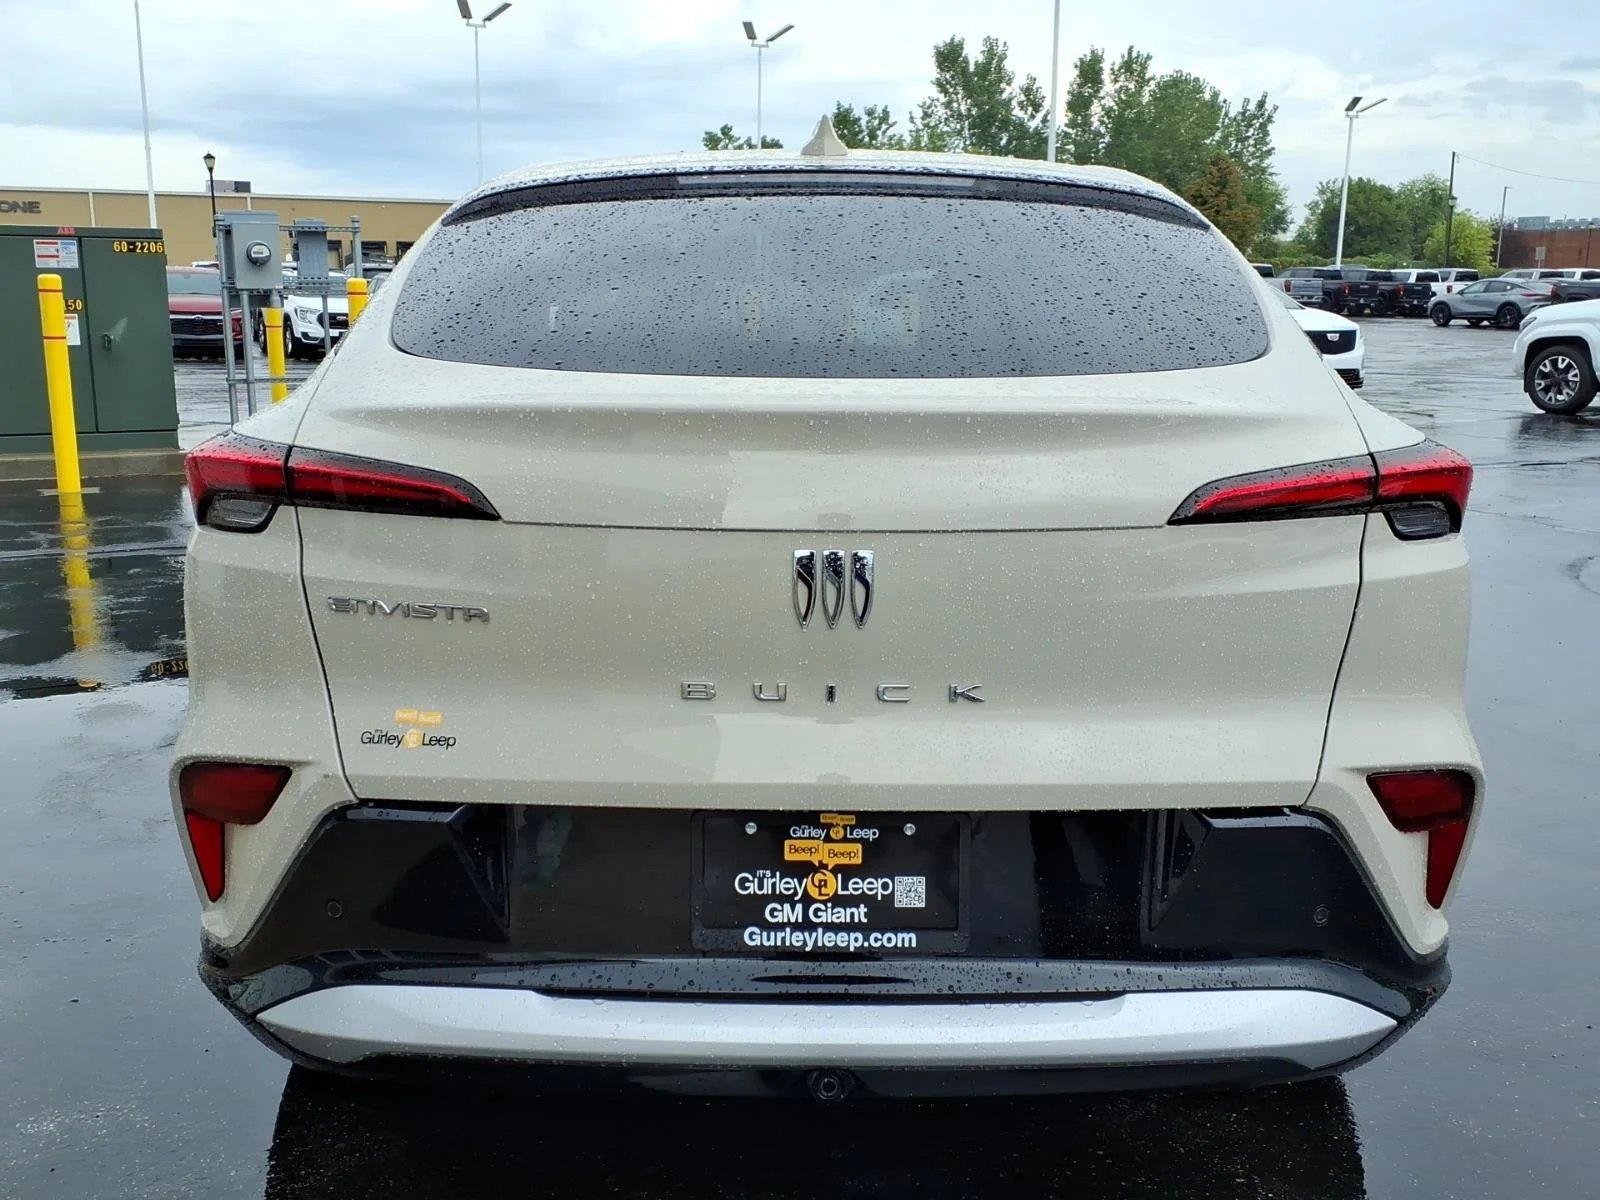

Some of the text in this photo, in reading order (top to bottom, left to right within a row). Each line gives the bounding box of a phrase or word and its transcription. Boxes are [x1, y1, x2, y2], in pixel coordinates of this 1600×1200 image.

[113, 241, 163, 253] 60-2206
[64, 299, 82, 310] 50
[327, 596, 490, 624] ENVISTA
[680, 680, 985, 703] BUICK
[422, 732, 457, 749] Leep
[847, 826, 879, 841] Leep
[789, 844, 820, 856] Beep!
[828, 848, 859, 860] Beep!
[734, 871, 807, 900] Gurley
[837, 873, 893, 900] Leep
[764, 902, 868, 923] GM Giant
[743, 926, 917, 951] Gurleyleep.com
